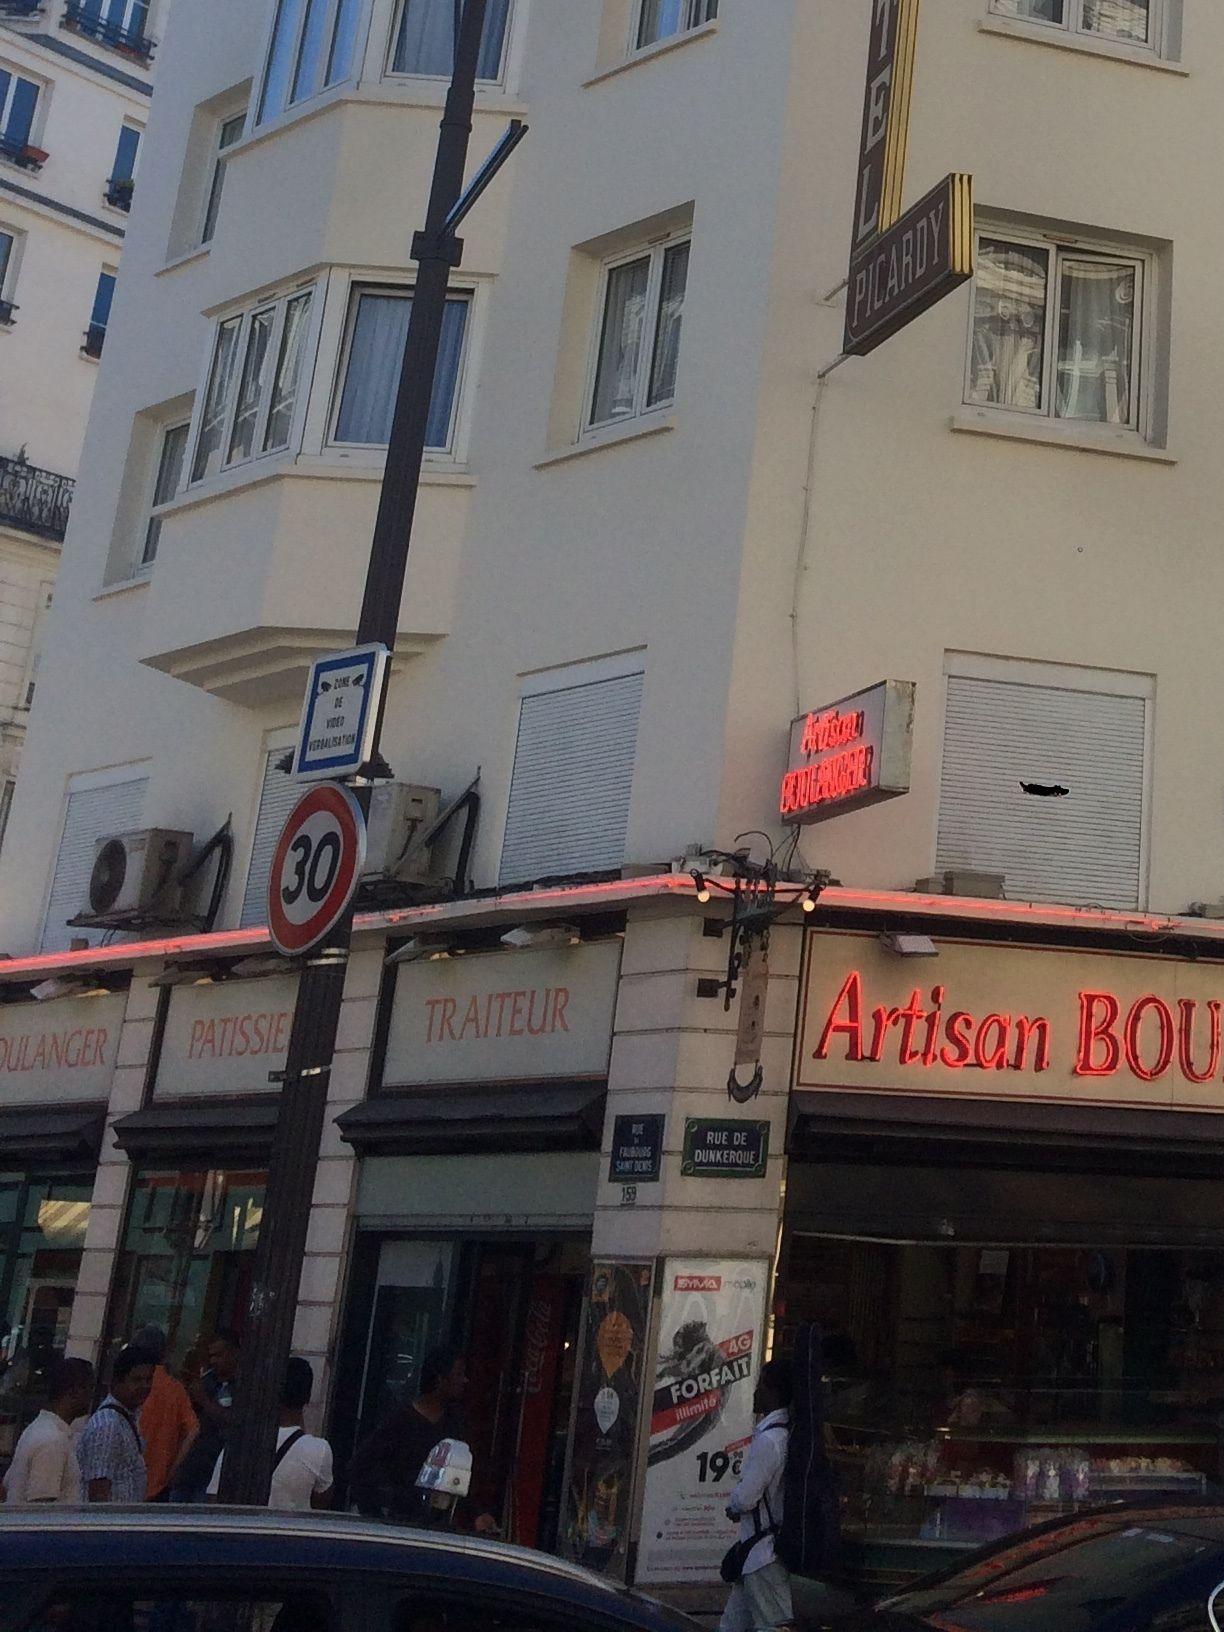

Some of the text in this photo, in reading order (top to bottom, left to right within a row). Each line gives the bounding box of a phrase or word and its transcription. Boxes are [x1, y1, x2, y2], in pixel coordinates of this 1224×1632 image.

[852, 201, 945, 329] PICARDY
[333, 675, 351, 690] ZONE
[334, 696, 343, 709] DE
[308, 733, 356, 752] VERBALISATION
[281, 831, 340, 904] 30
[424, 987, 570, 1044] TRAITEUR
[814, 972, 1049, 1072] Artisan
[188, 1012, 294, 1060] PATISSIE
[631, 1123, 645, 1136] RUE
[706, 1131, 748, 1146] RUE DE
[619, 1146, 652, 1158] FAUBOURG
[694, 1149, 756, 1165] DUNKERQUE
[621, 1186, 637, 1202] 159
[728, 1334, 752, 1354] 4G
[669, 1357, 751, 1405] FORFAIT
[696, 1451, 730, 1483] 19
